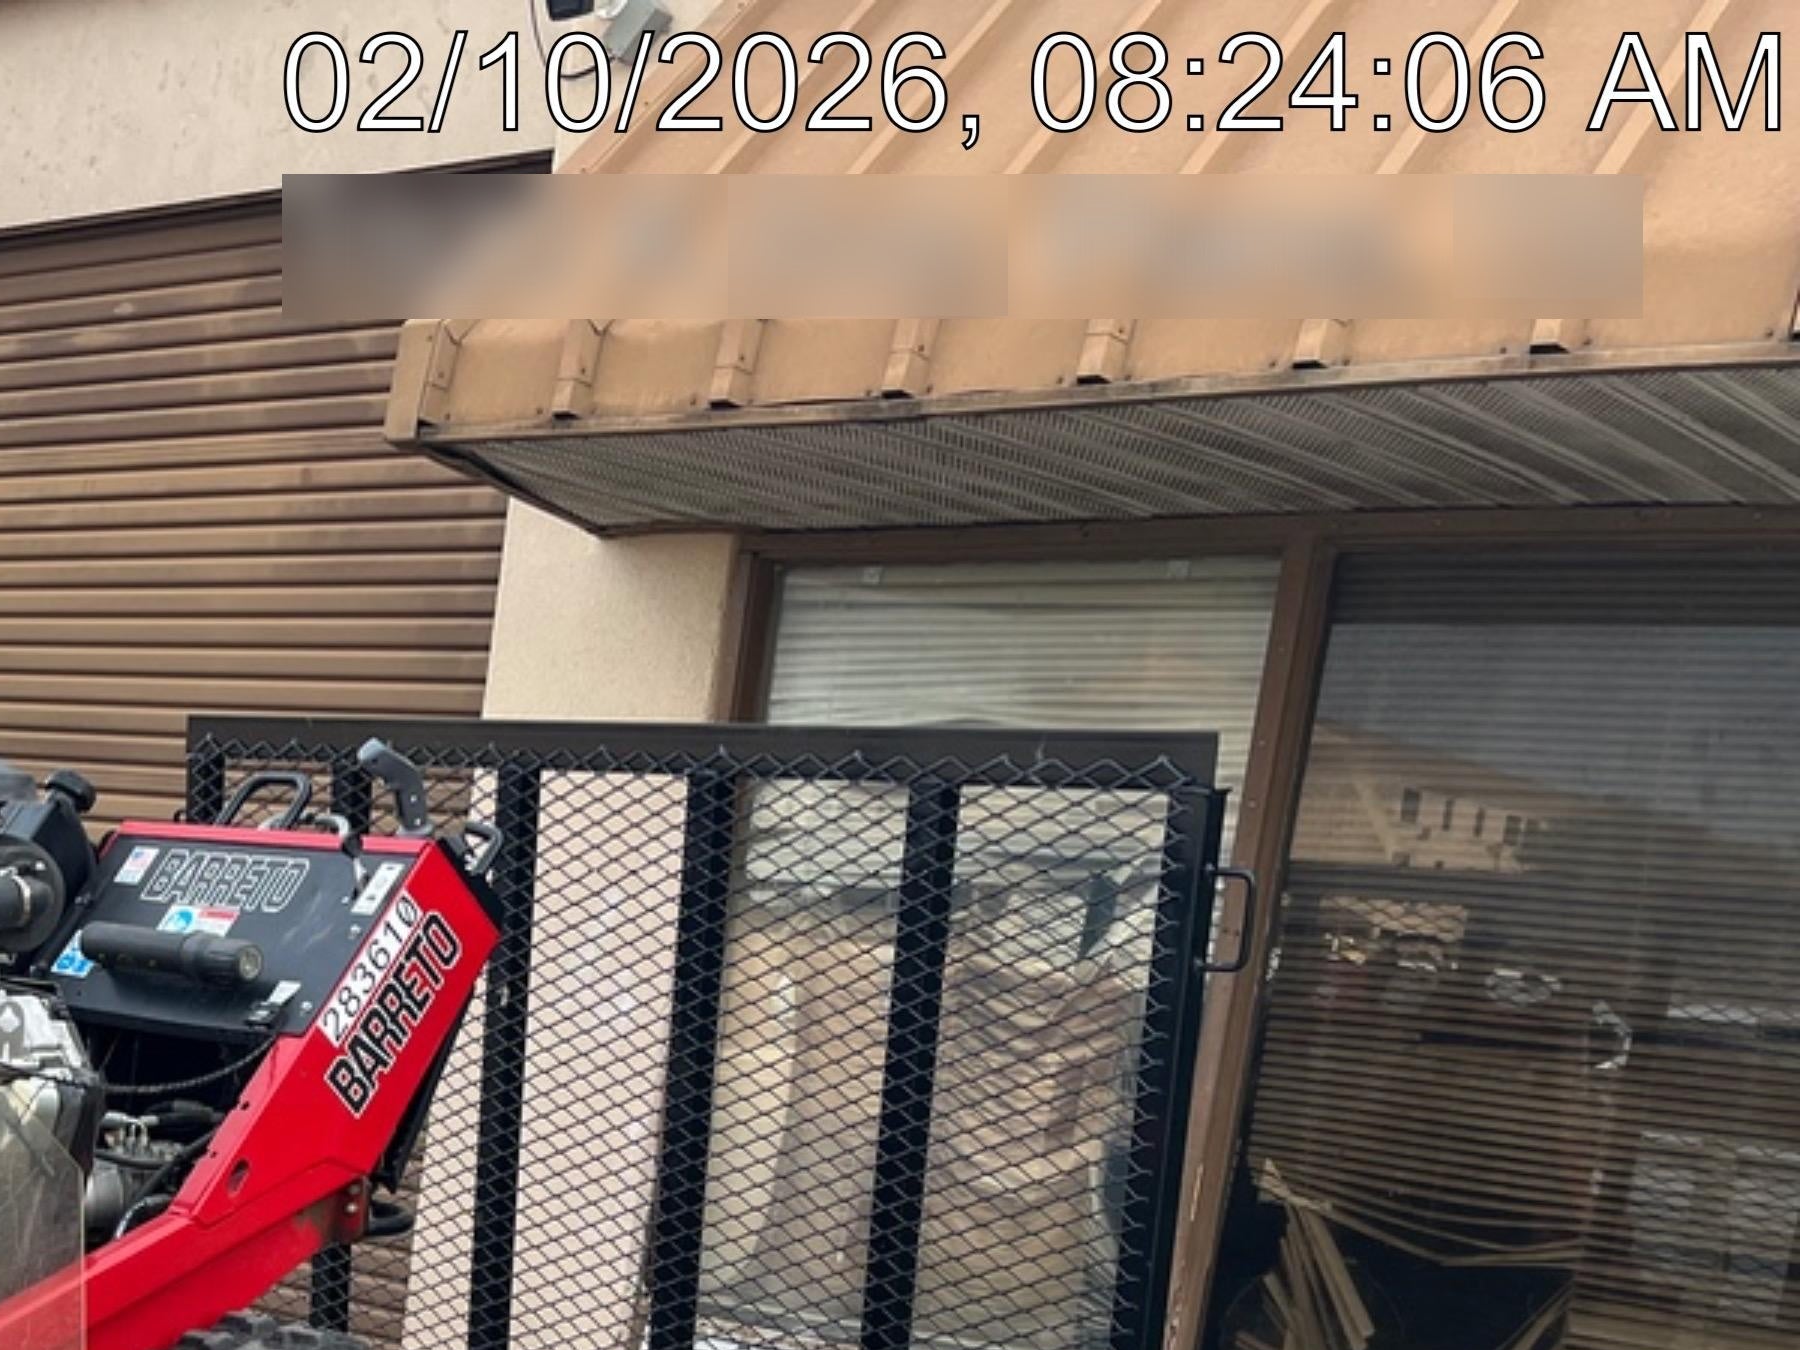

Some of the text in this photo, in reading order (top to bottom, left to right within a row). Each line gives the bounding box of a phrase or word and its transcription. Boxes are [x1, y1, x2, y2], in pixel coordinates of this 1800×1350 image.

[141, 848, 310, 913] BARRETO
[321, 895, 420, 1043] 283610
[323, 911, 462, 1118] BARRETO
